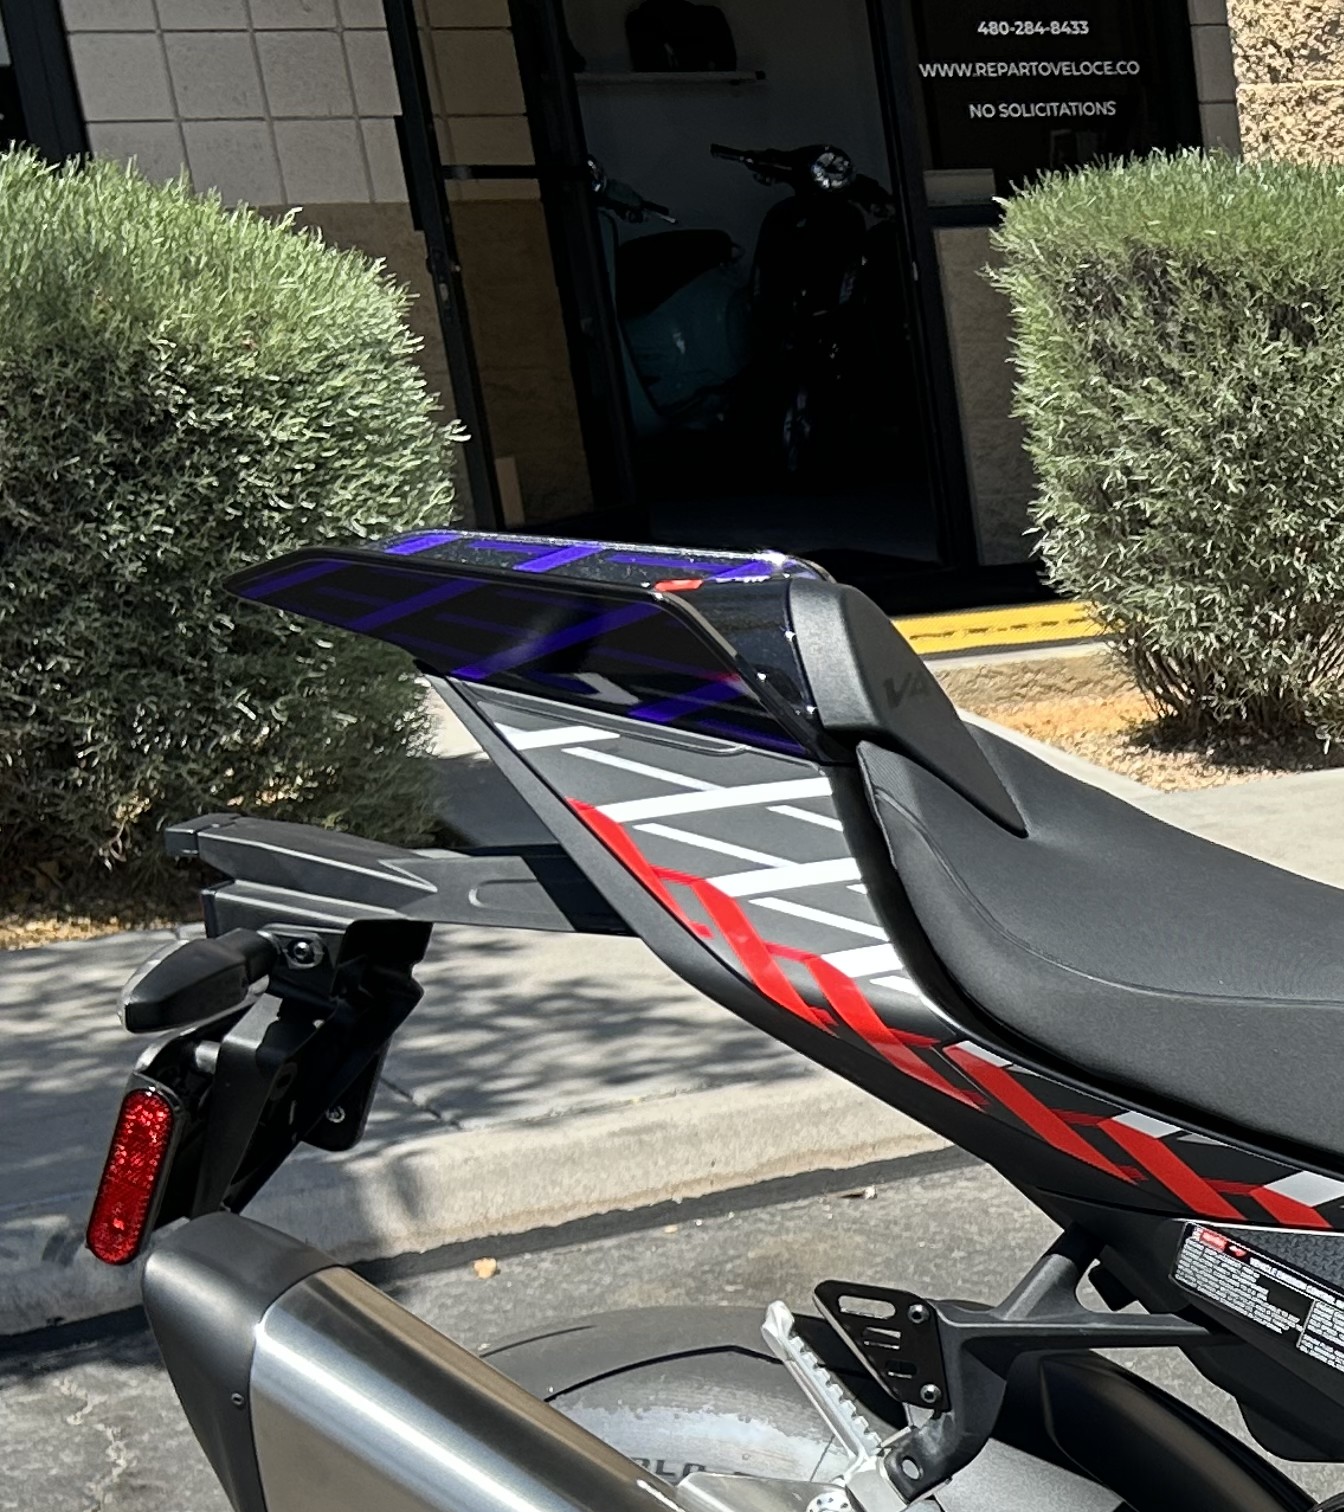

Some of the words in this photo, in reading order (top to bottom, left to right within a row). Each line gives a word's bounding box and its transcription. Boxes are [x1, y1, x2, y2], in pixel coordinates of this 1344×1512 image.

[977, 20, 1089, 36] 480-284-8433
[918, 60, 1140, 78] WWW.REPARTOVELOCE.CO
[969, 102, 996, 119] NO
[998, 100, 1117, 118] SOLICITATIONS
